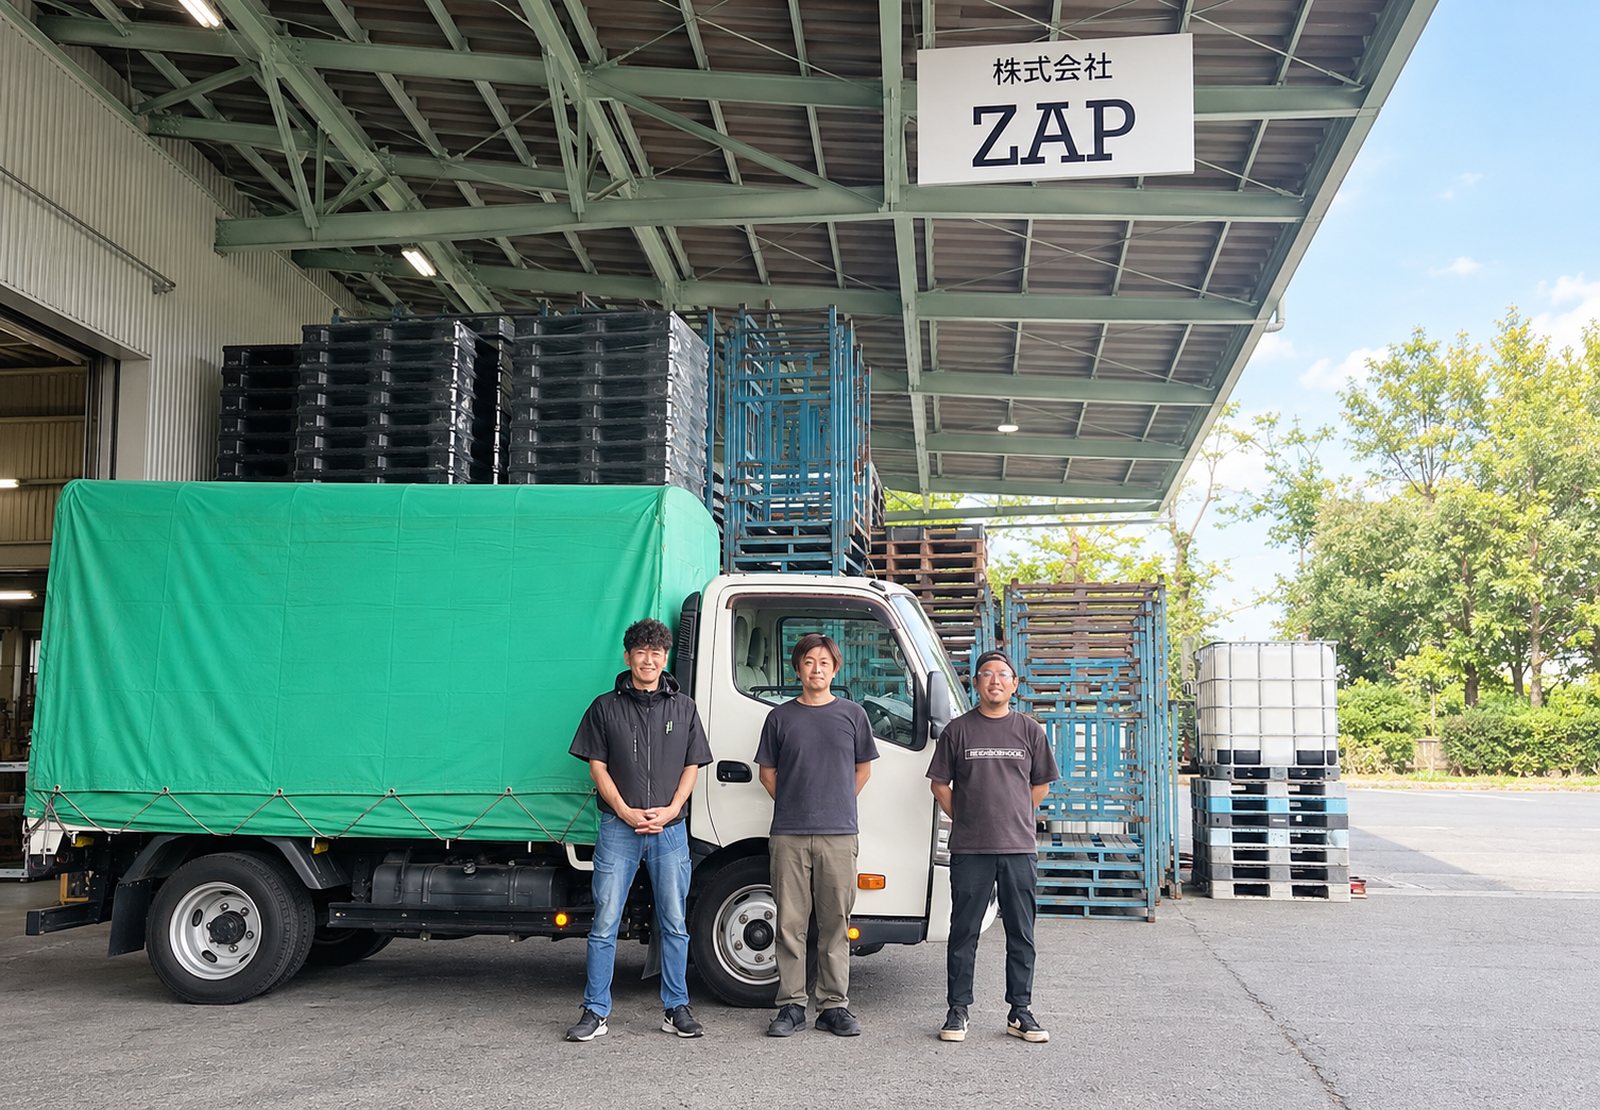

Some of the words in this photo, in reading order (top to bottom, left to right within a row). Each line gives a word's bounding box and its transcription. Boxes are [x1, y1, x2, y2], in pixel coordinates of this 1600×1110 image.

[992, 52, 1113, 86] 株式会社
[972, 98, 1136, 167] ZAP
